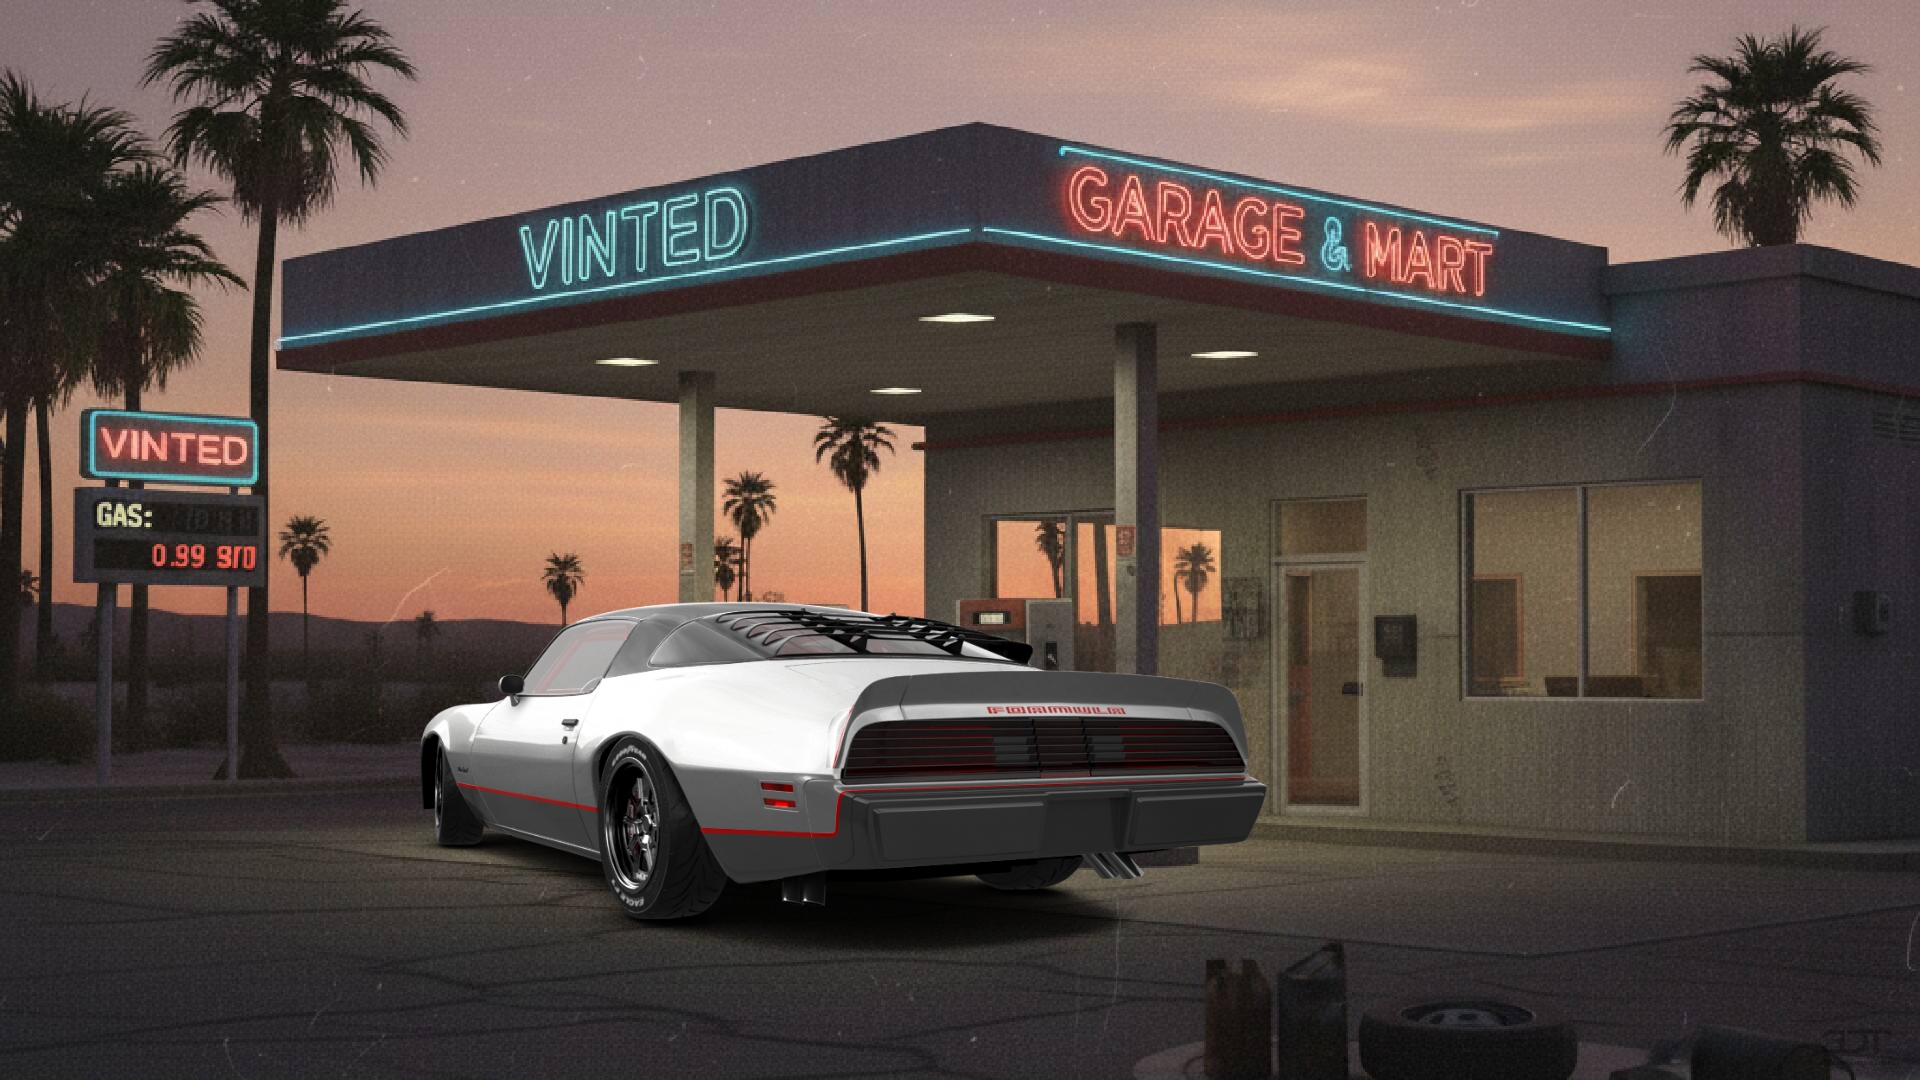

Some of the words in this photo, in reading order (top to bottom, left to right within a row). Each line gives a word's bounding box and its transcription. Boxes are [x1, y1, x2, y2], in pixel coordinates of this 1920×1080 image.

[519, 186, 749, 290] VINTED
[1068, 166, 1306, 271] GARAGE
[1321, 216, 1352, 272] &
[1365, 221, 1494, 297] MART
[100, 427, 248, 466] VINTED
[96, 501, 153, 528] GAS:
[152, 543, 206, 568] 0.99
[986, 705, 1127, 715] FORMULA
